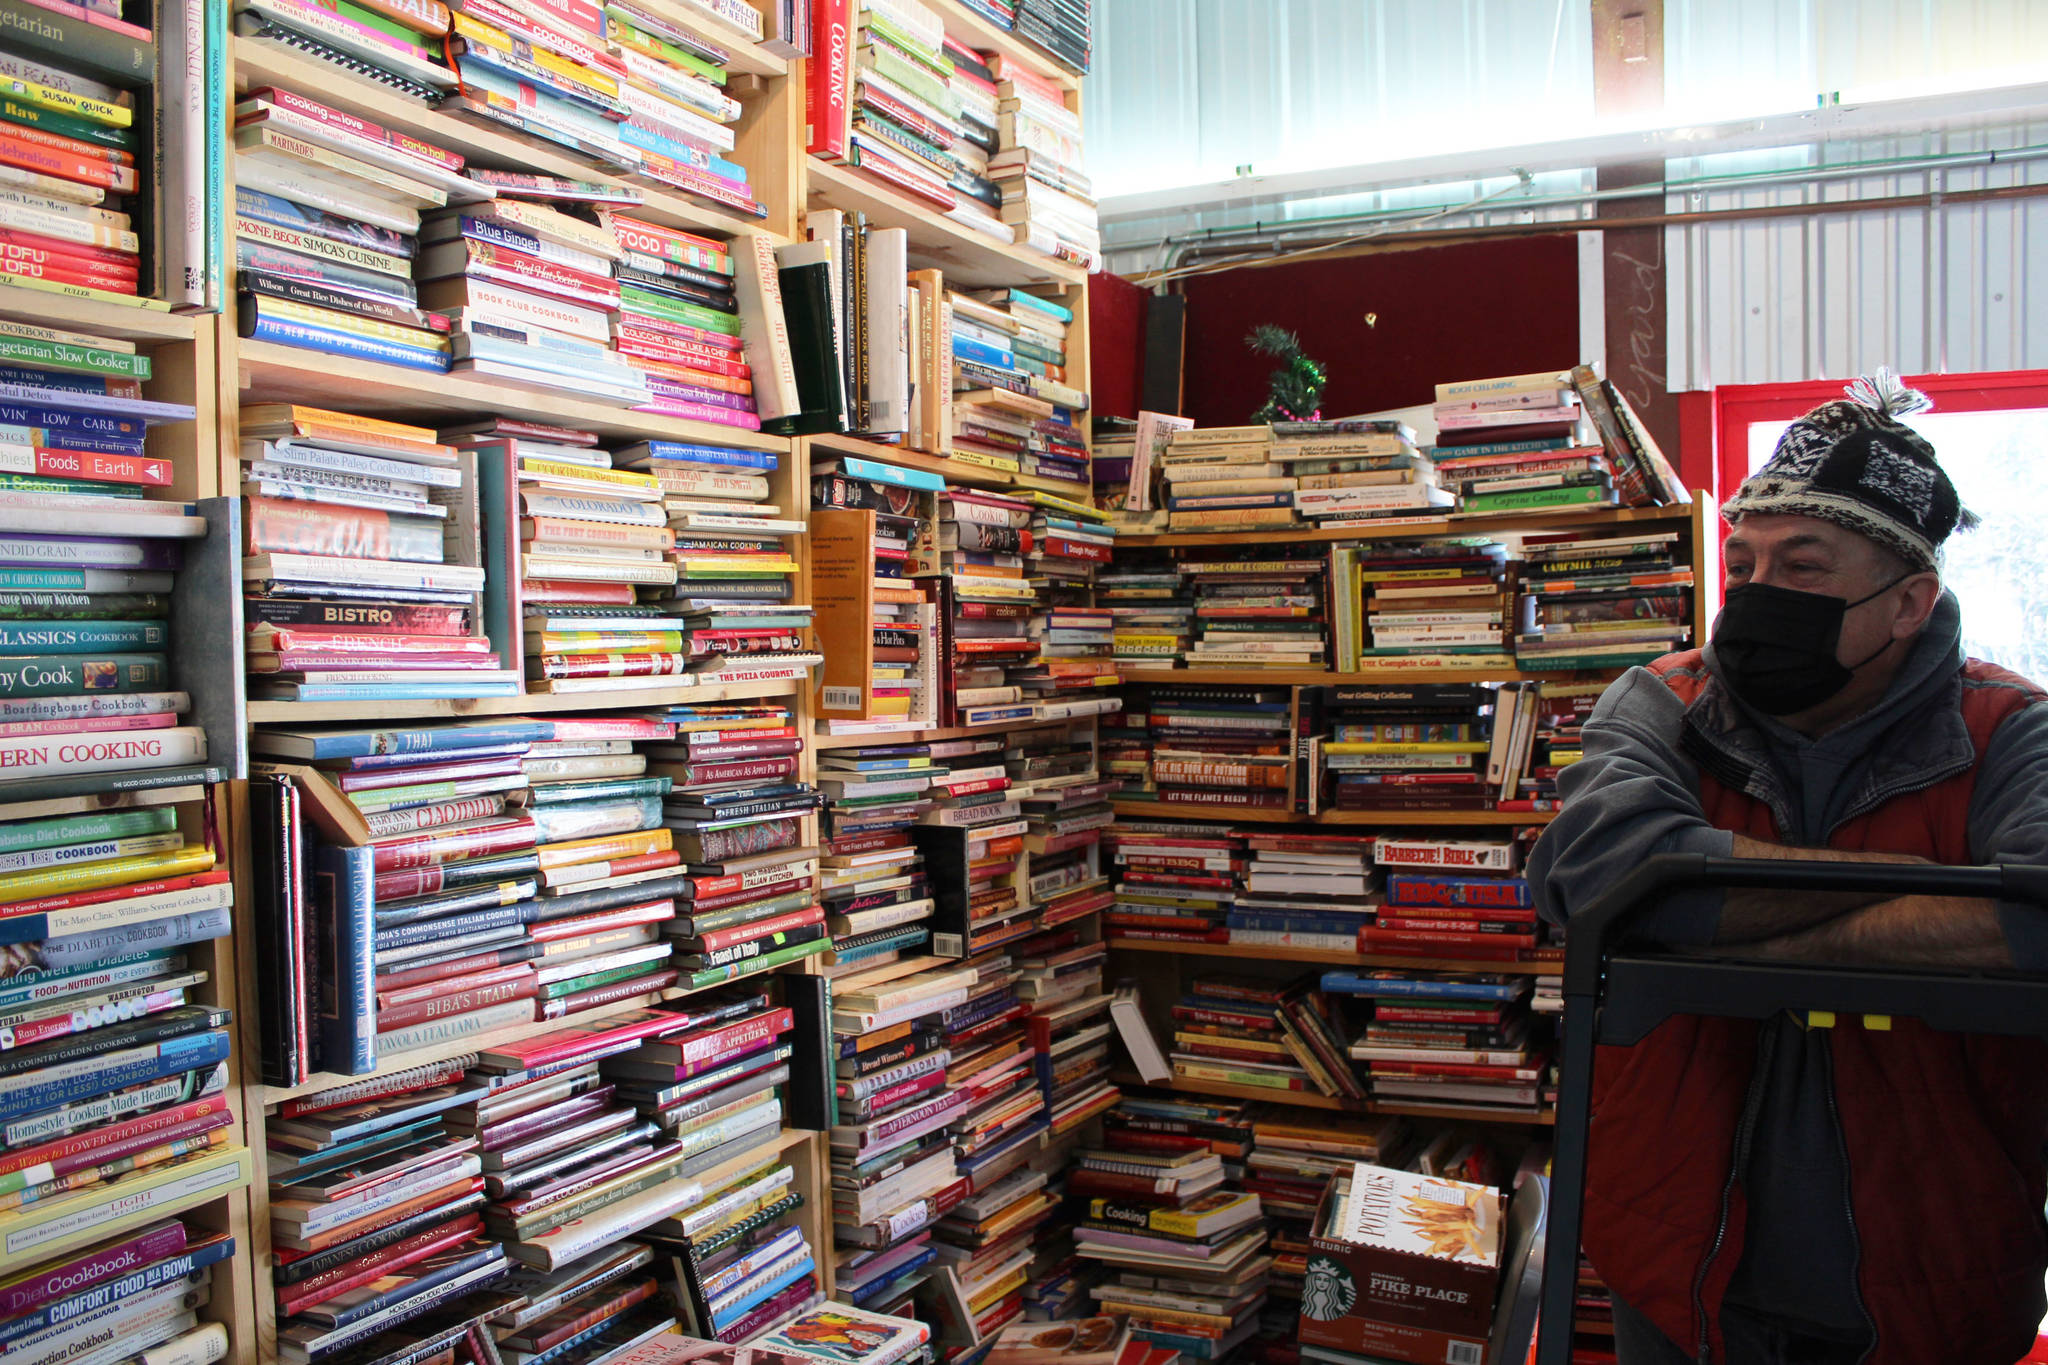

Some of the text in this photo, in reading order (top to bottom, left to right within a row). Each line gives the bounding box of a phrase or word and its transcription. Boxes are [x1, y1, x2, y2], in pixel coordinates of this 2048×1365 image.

[730, 1, 757, 19] MOLLY
[532, 25, 595, 61] COOKBOOK
[831, 22, 845, 110] COOKING
[4, 102, 40, 122] Raw
[41, 90, 113, 116] SUSAN QUICK
[621, 91, 668, 117] SANDRA LEE
[284, 94, 446, 161] cooking love carla hall
[624, 129, 656, 145] AROUND
[270, 134, 314, 158] MARINADES
[46, 199, 69, 212] Meat
[475, 220, 540, 251] Blue Ginger
[617, 228, 660, 253] FOOD
[273, 230, 392, 270] BECK SIMCA'S CUISINE
[63, 287, 90, 297] FULLER
[258, 278, 393, 316] Wilson Great Rice Dishes World
[477, 291, 581, 325] BOOK CLUB COOKBOOK
[623, 327, 730, 358] COLICCHIO THINK LIKE CHEF
[55, 345, 130, 371] Slow Cooker
[42, 411, 115, 430] LOW CARB
[655, 443, 729, 458] BAREFOOT CONTESSA
[1454, 448, 1478, 456] GAME
[1510, 441, 1549, 451] KITCHEN
[40, 453, 134, 477] Foods Earth
[284, 449, 415, 479] Slim Palate Paleo Cookbook
[1475, 467, 1510, 477] Kitchen
[670, 469, 752, 490] FRUGAL JEFF SMITH
[559, 498, 633, 514] COLORADO
[37, 545, 78, 558] GRAIN
[690, 540, 762, 550] JAMAICAN COOKING
[43, 574, 83, 585] COOKBOOK
[756, 585, 782, 593] COOKBOOK
[324, 607, 393, 623] BISTRO
[996, 605, 1017, 616] cookies
[80, 632, 139, 642] COOKBOOK
[705, 639, 728, 650] Pizza
[1379, 659, 1418, 668] Complete
[21, 665, 74, 685] Cook
[719, 669, 794, 681] THE PIZZA GOURMET
[4, 700, 148, 716] Boardinghouse Cookbook
[58, 740, 162, 763] COOKING
[405, 733, 433, 750] THAI
[715, 764, 767, 778] AMERICAN APPLE
[1168, 792, 1247, 803] LET THE FLAMES BEGIN
[416, 798, 495, 828] CIAO ITALIA
[724, 802, 781, 817] FRESH ITALIAN
[954, 806, 1002, 821] BREAD BOOK
[61, 822, 112, 839] Cookbook
[55, 843, 117, 860] COOKBOOK
[1383, 845, 1475, 865] BARBECUE! BIBLE
[744, 870, 794, 888] ITALIAN KITCHEN
[1397, 882, 1519, 906] BBQ USA
[54, 915, 91, 929] The Mayo
[401, 908, 515, 937] COMMONSENSE ITALIAN COOKING
[67, 925, 169, 952] DIABETES COOKBOOK
[710, 942, 759, 966] Feast Italy
[34, 974, 111, 998] FOOD NUTRITION
[107, 985, 155, 1003] WARRINGTON
[589, 978, 665, 1004] ARTISANAL COOKING
[426, 982, 519, 1017] BIBA'S ITALY
[17, 1018, 70, 1040] Raw Energy
[725, 1027, 769, 1049] APPETIZERS
[18, 1035, 137, 1069] COUNTRY GARDEN COOKBOOK
[861, 1059, 881, 1071] Bread
[9, 1081, 179, 1141] Homestyle Cooking Made Healthy
[888, 1101, 948, 1133] AFTERNOON TEA
[556, 1180, 594, 1201] COOKING
[111, 1192, 152, 1211] LIGHT
[1358, 1175, 1395, 1238] POTATOES
[892, 1207, 926, 1233] Cookies
[1105, 1206, 1147, 1226] Cooking
[1312, 1240, 1351, 1253] KEURIG
[689, 1249, 707, 1303] GARNISHING
[11, 1287, 47, 1310] Diet
[50, 1256, 195, 1323] COMFORT FOOD BOWL
[1370, 1278, 1468, 1304] PIKE PLACE
[351, 1296, 387, 1320] sushi
[69, 1328, 114, 1356] Cookbook
